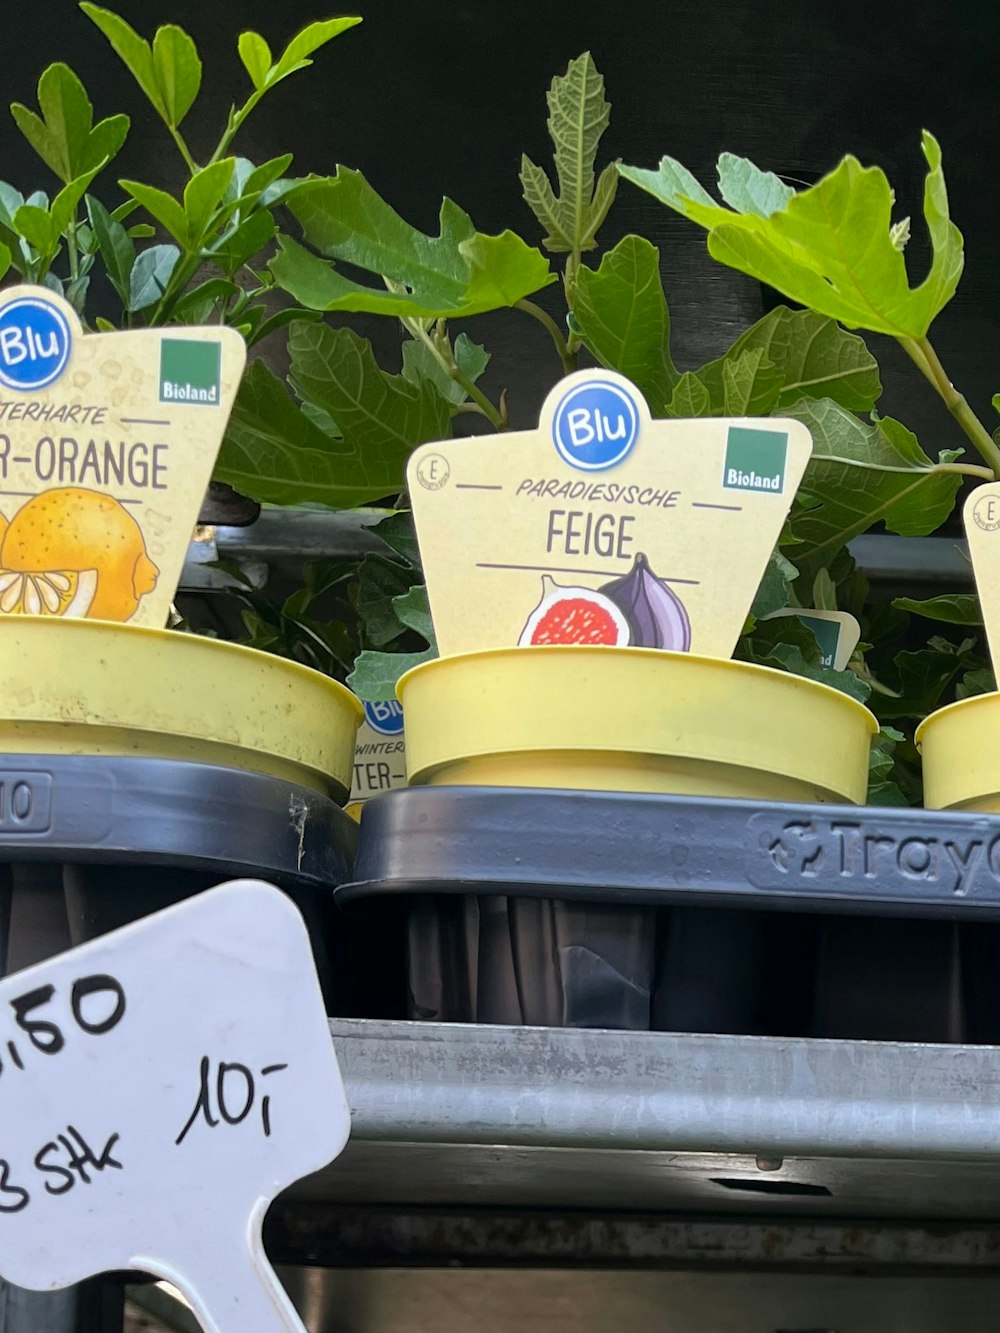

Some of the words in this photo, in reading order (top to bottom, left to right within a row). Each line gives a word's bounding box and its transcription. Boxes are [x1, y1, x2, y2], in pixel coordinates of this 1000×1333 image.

[1, 325, 60, 366] Blu
[163, 382, 217, 401] Bioland
[567, 408, 626, 447] Blu
[430, 459, 438, 480] E
[727, 468, 780, 490] Bioland
[516, 479, 681, 508] PARADIESISCHE
[988, 501, 996, 521] E
[546, 509, 636, 559] FEIGE
[0, 973, 127, 1077] ,50
